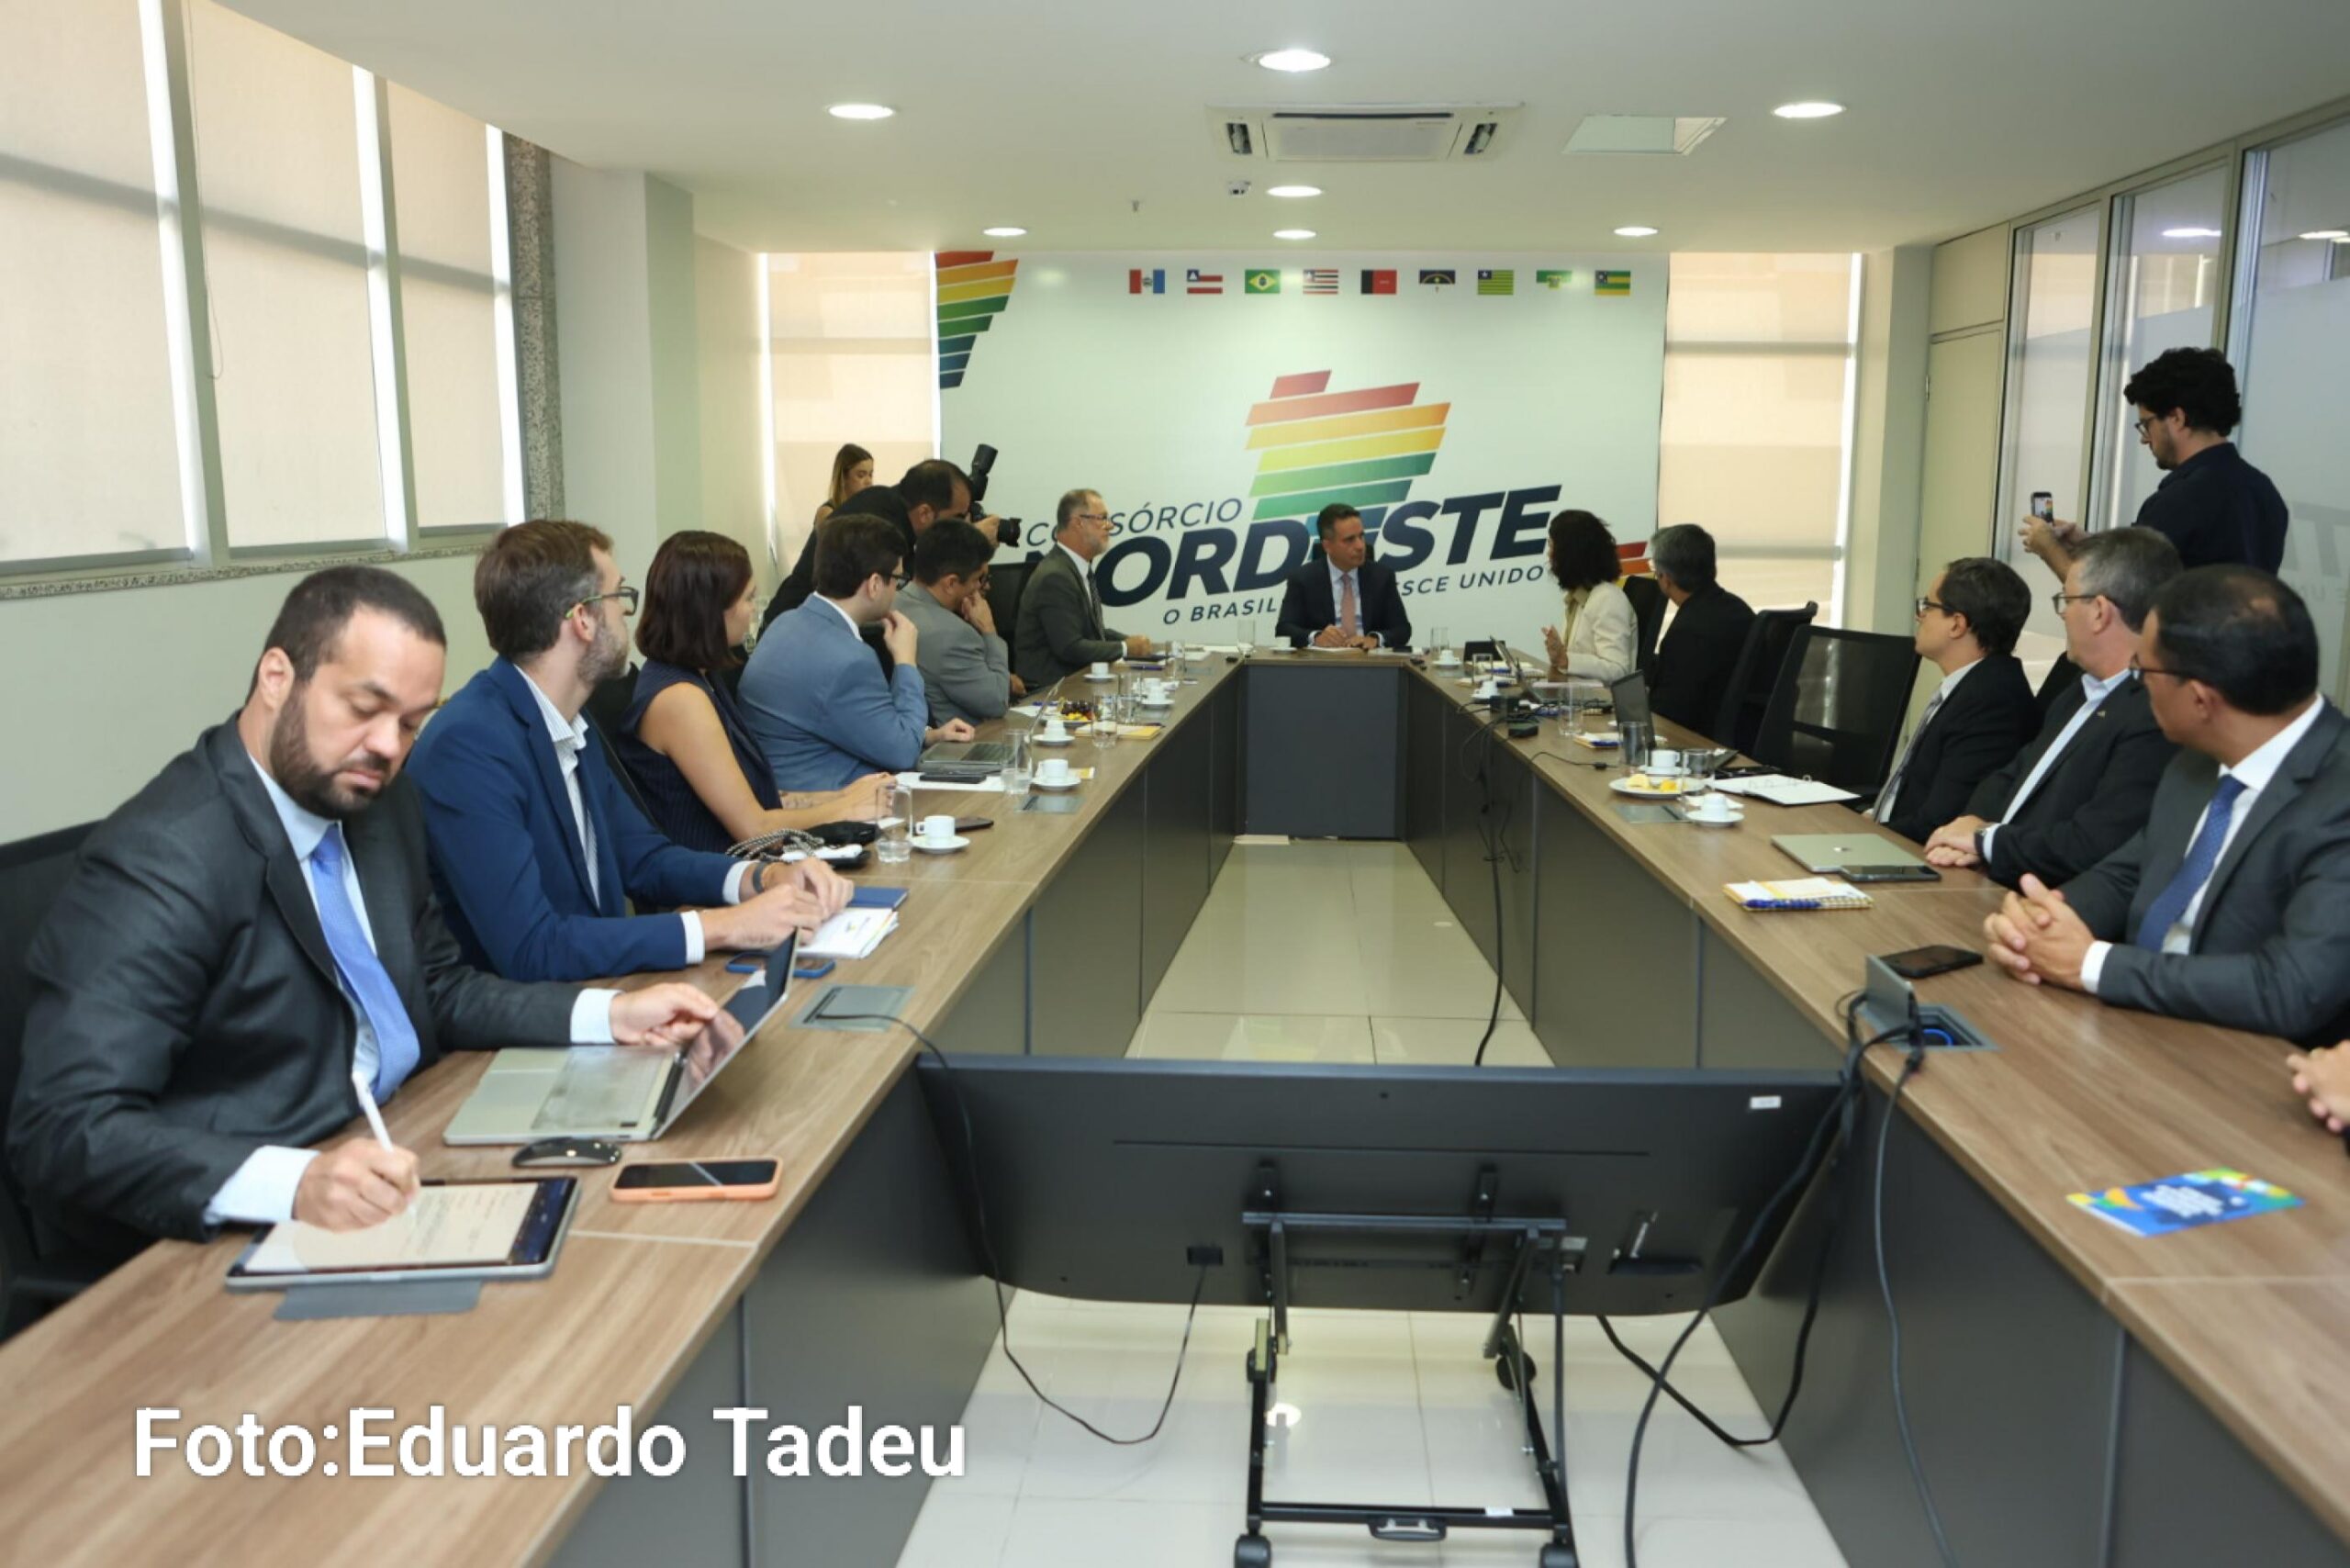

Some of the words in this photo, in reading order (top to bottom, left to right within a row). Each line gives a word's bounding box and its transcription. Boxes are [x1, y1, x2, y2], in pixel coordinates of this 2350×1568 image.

[1025, 485, 1562, 608] ORDSTE
[1026, 498, 1242, 546] CSÓRCIO
[1163, 609, 1180, 625] O
[1191, 598, 1277, 622] BRASIL
[1460, 566, 1544, 589] UNIDO
